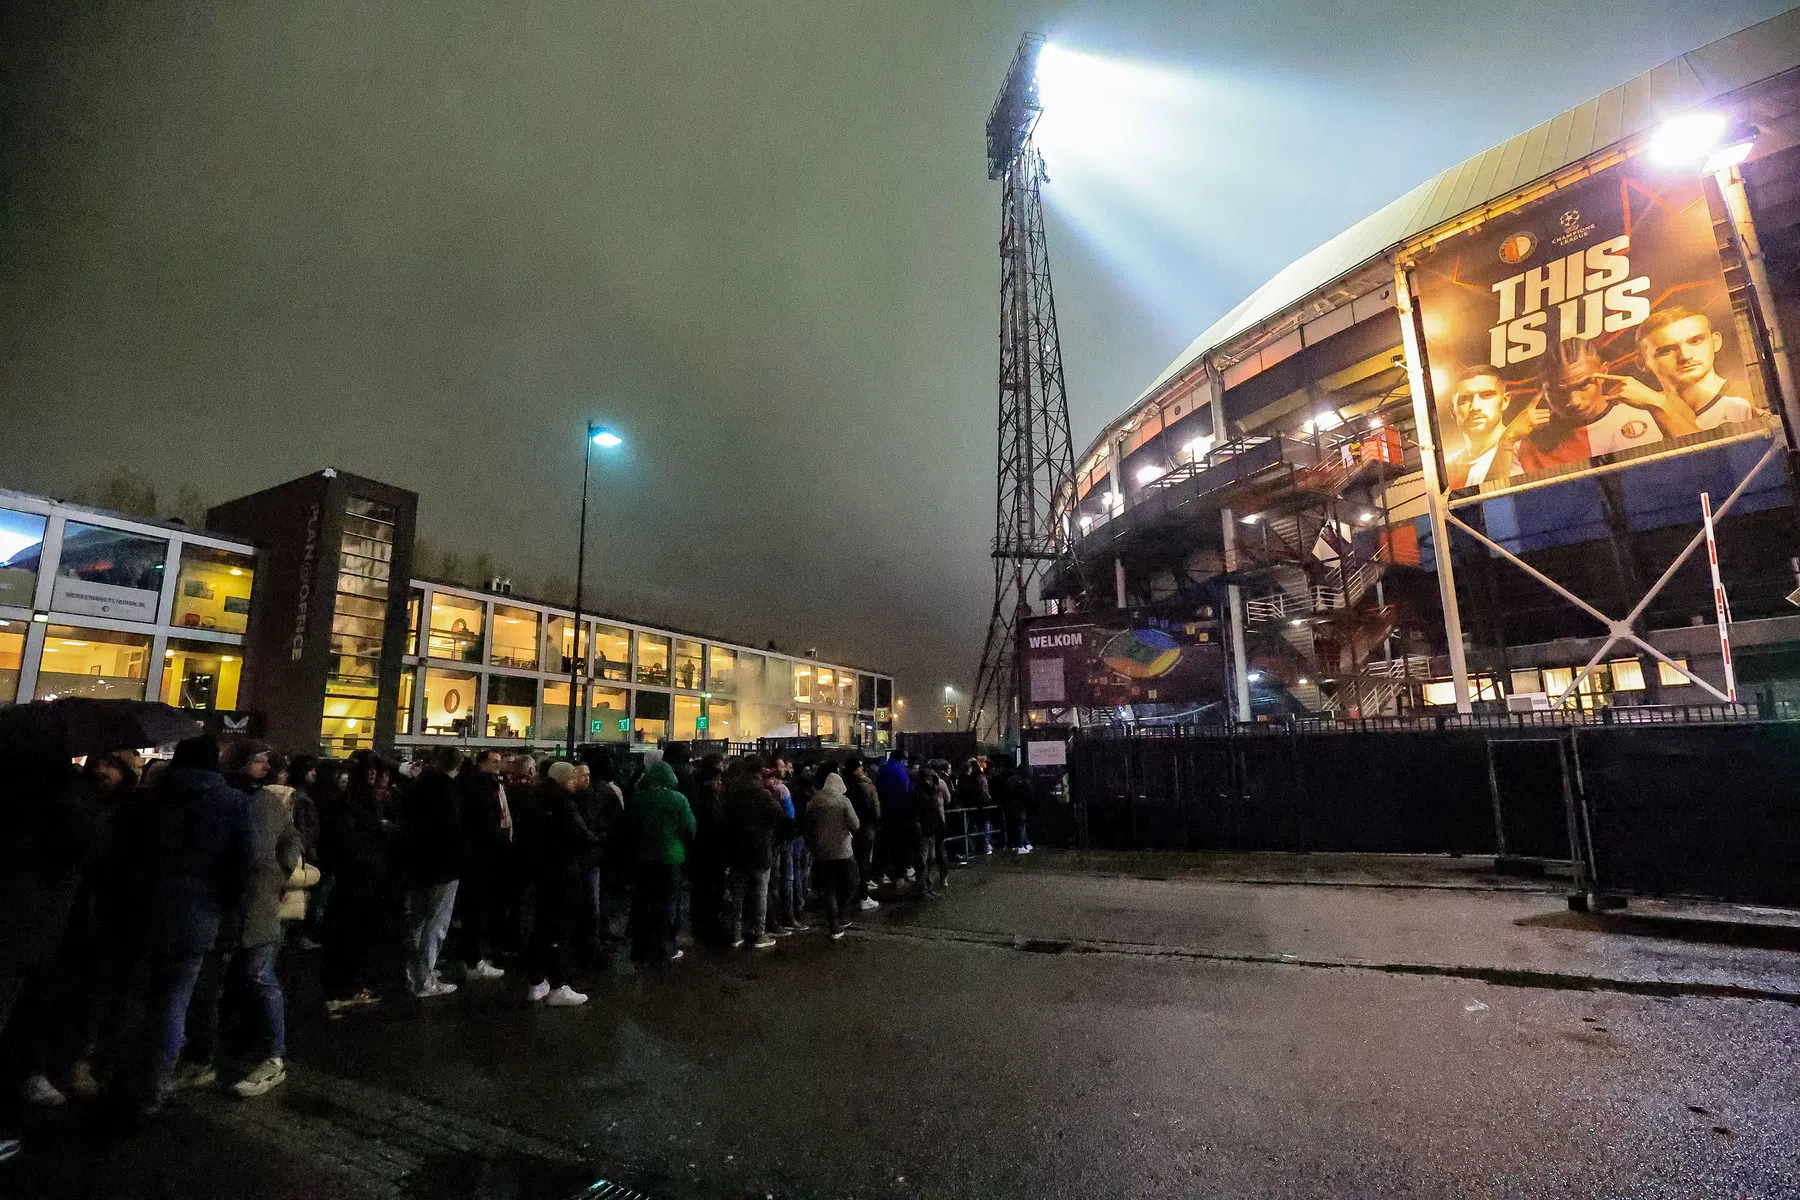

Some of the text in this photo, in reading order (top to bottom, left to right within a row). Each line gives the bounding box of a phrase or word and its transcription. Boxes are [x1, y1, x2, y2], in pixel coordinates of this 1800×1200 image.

[1551, 223, 1596, 244] CHAMPIONS
[1560, 232, 1589, 246] LEAGUE
[1491, 234, 1630, 325] THIS
[1488, 275, 1651, 369] IS US
[1029, 632, 1083, 649] WELKOM
[880, 710, 885, 719] 8
[946, 708, 952, 716] 9
